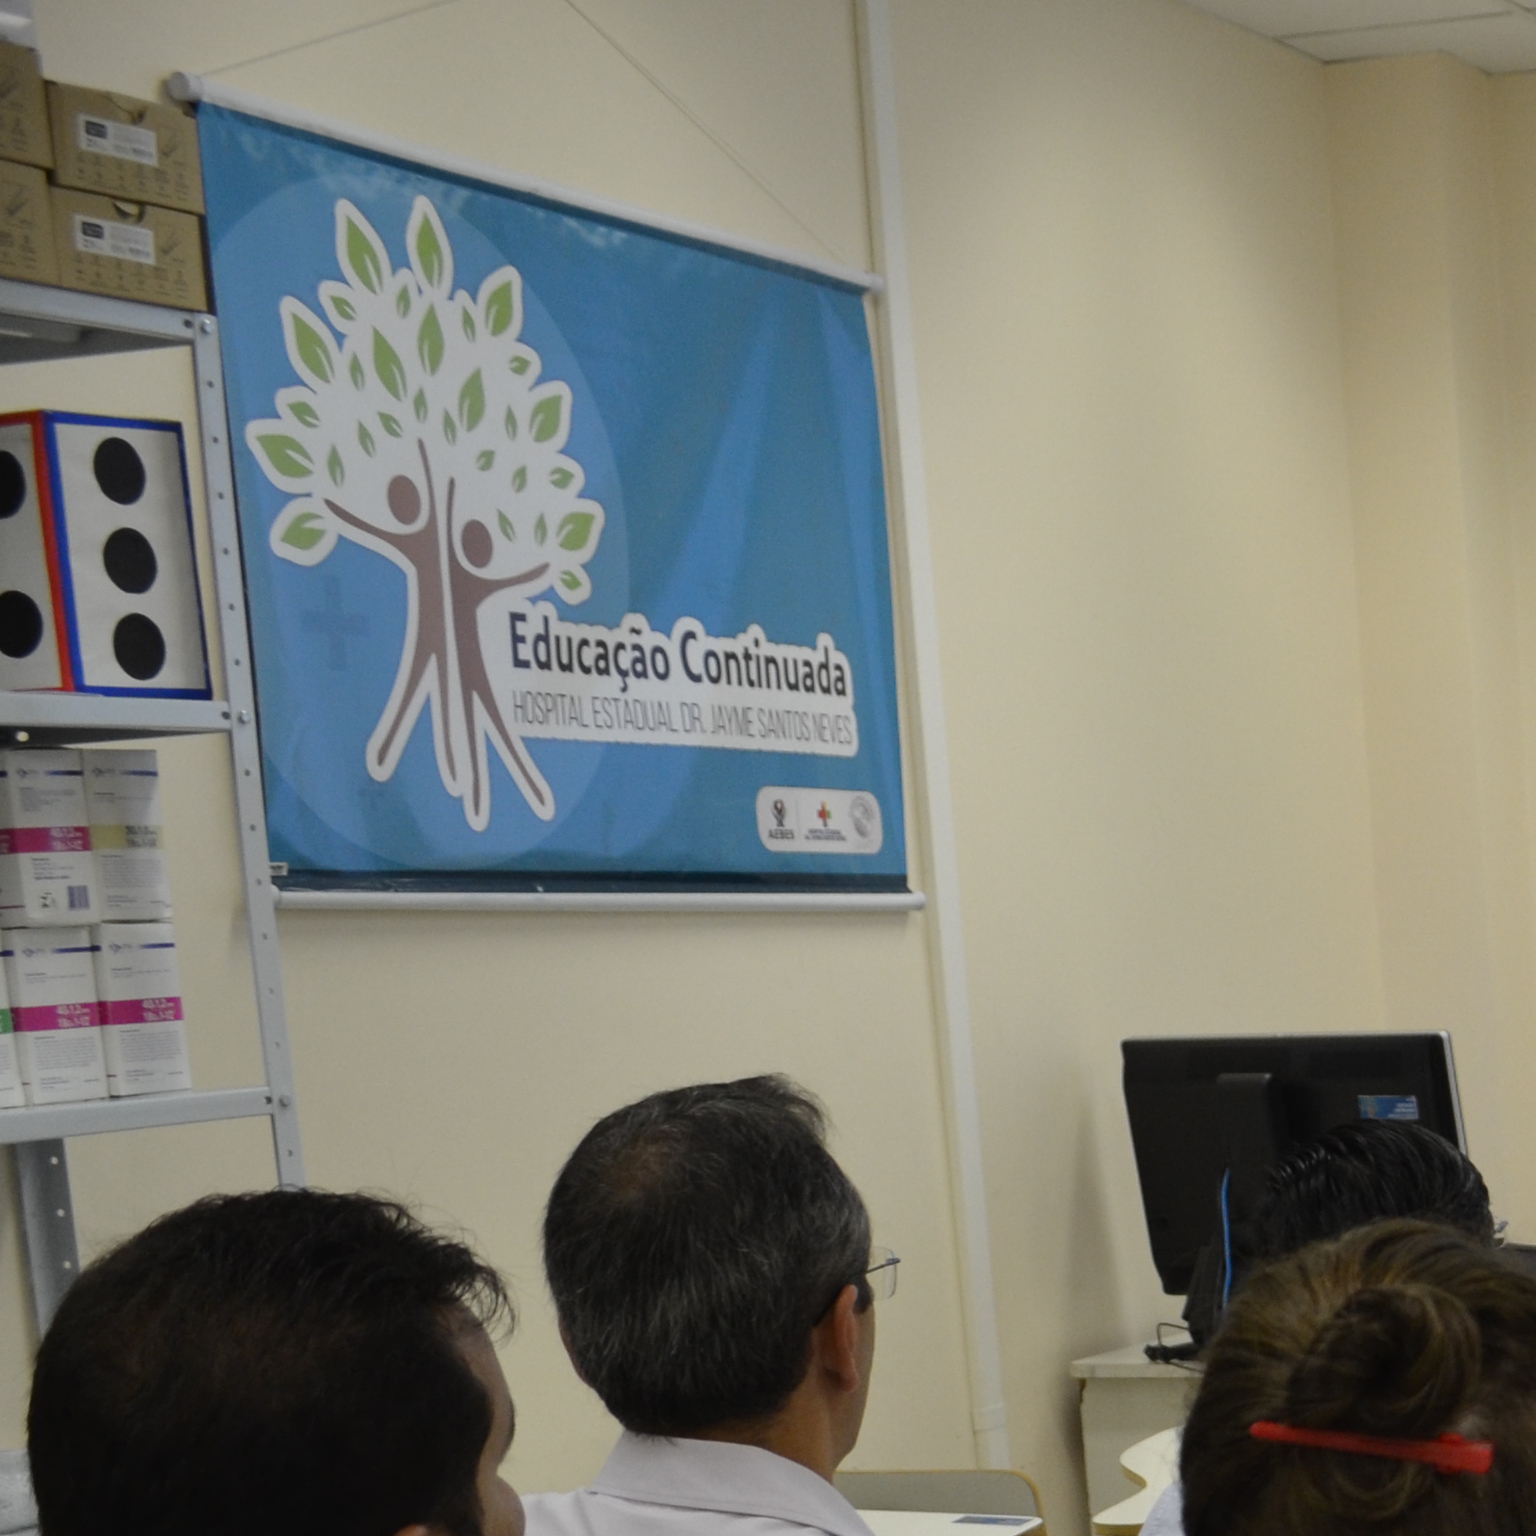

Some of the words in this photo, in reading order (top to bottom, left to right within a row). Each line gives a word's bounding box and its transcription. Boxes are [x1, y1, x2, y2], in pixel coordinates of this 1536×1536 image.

[509, 610, 670, 694] Educação
[680, 629, 847, 697] Continuada
[512, 690, 589, 727] HOSPITAL
[591, 696, 678, 732] ESTADUAL
[680, 701, 706, 734] DR.
[709, 704, 755, 738] JAYME
[757, 707, 810, 742] SANTOS
[811, 712, 853, 745] NEVES
